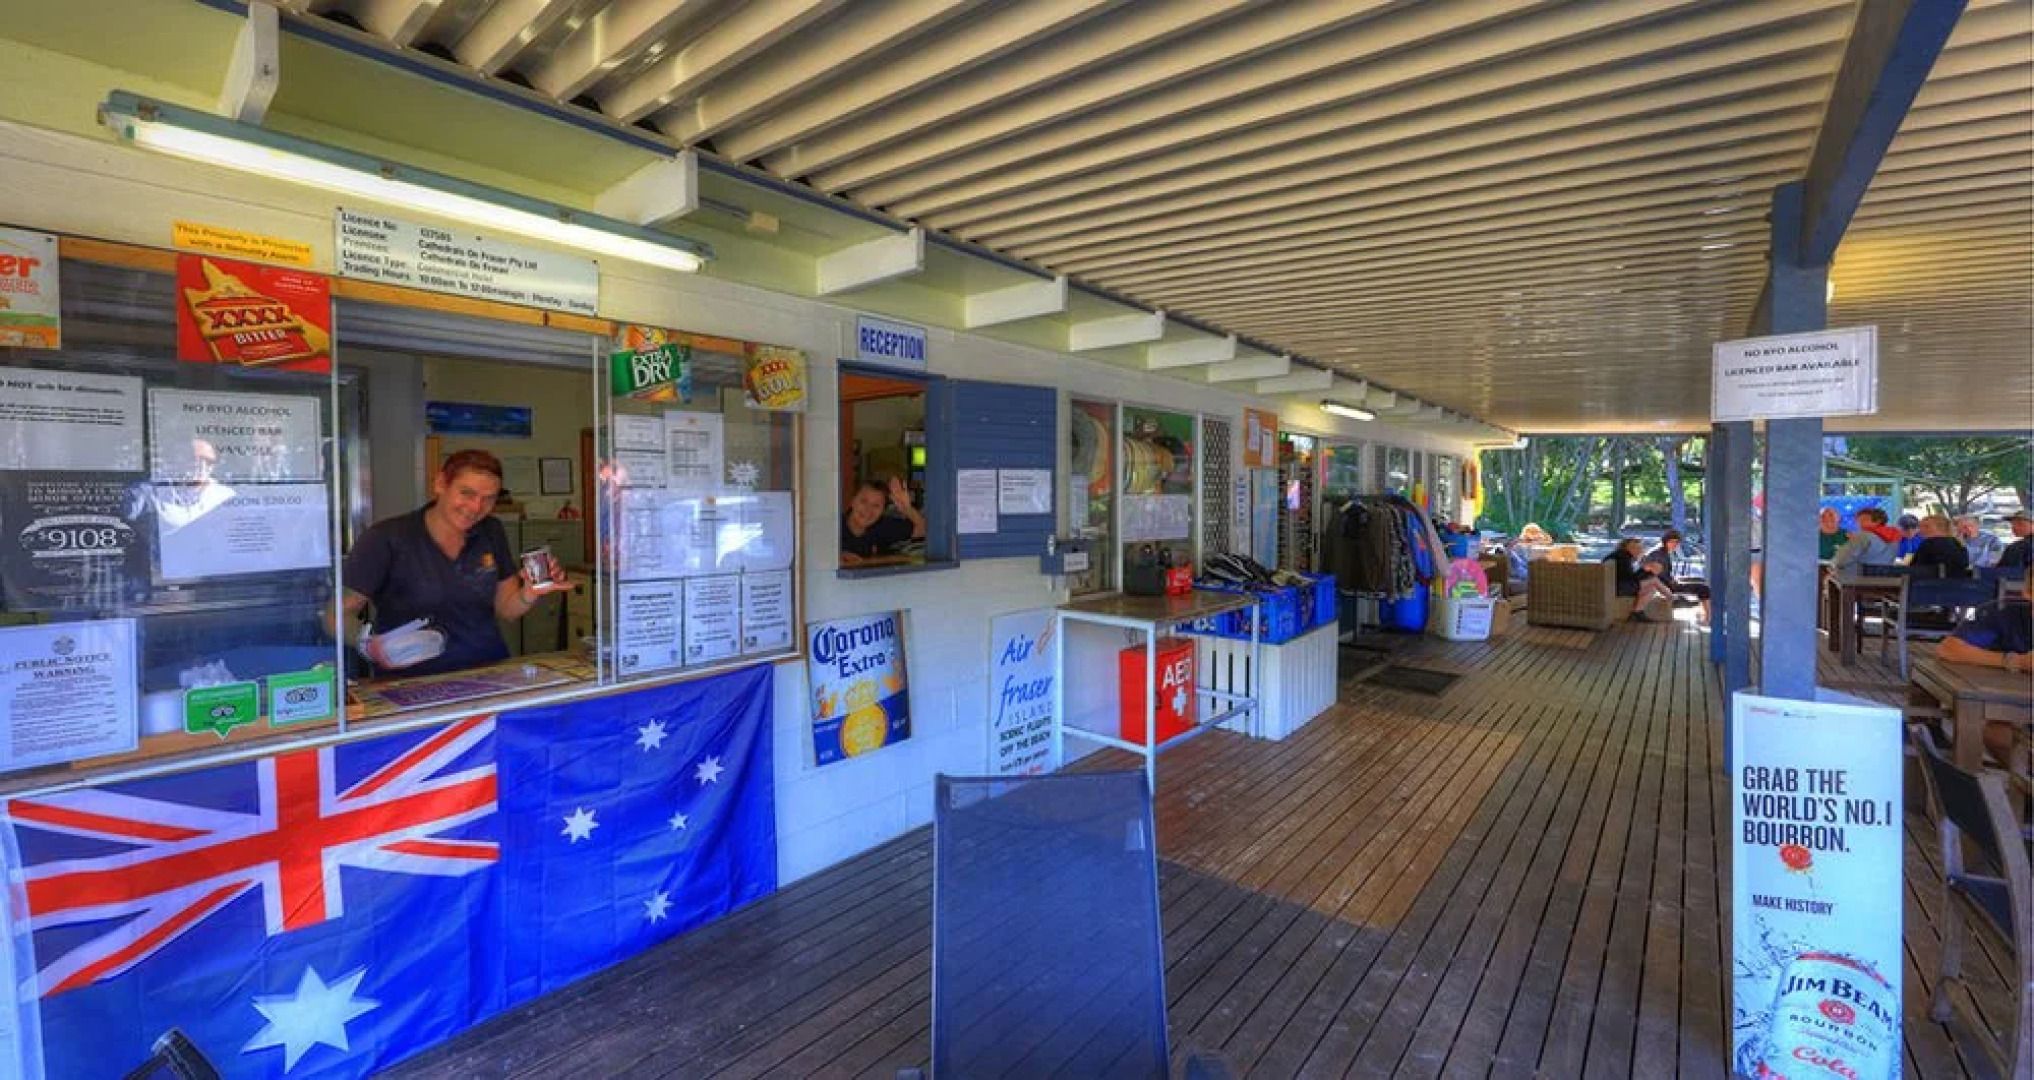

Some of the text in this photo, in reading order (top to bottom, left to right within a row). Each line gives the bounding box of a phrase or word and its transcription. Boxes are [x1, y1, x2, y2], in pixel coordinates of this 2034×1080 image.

[342, 213, 381, 228] Licence
[343, 249, 381, 265] Licence
[418, 239, 465, 256] Cathedrals
[481, 252, 508, 265] Fraser
[420, 251, 467, 268] Cathedrals
[203, 308, 294, 330] XXXX
[235, 330, 286, 345] BITTER
[861, 326, 925, 361] RECEPTION
[1744, 342, 1839, 359] NO BYO ALCOHOL
[632, 349, 672, 369] EXTRA
[1724, 358, 1860, 378] LICENCED BAR AVAILABLE
[634, 362, 671, 388] DRY
[183, 402, 292, 417] NO BYO ALCOHOL
[196, 424, 283, 436] LICENCED BAR
[813, 616, 896, 667] Corona
[1000, 635, 1034, 666] Air
[15, 653, 113, 671] PUBLIC NOTICE
[33, 667, 97, 679] WARNING
[839, 650, 886, 679] Extra
[994, 673, 1054, 728] fraser
[999, 715, 1052, 743] SCENIC FLIGHTS
[999, 730, 1051, 758] OFF THE BEACH
[1743, 766, 1848, 796] GRAB THE
[1743, 793, 1838, 825] WORLD'S
[1743, 820, 1851, 855] BOURBON.
[1752, 894, 1834, 917] MAKE HISTORY
[1781, 975, 1893, 1032] JIM BEAM
[1789, 1014, 1878, 1052] BOURBON
